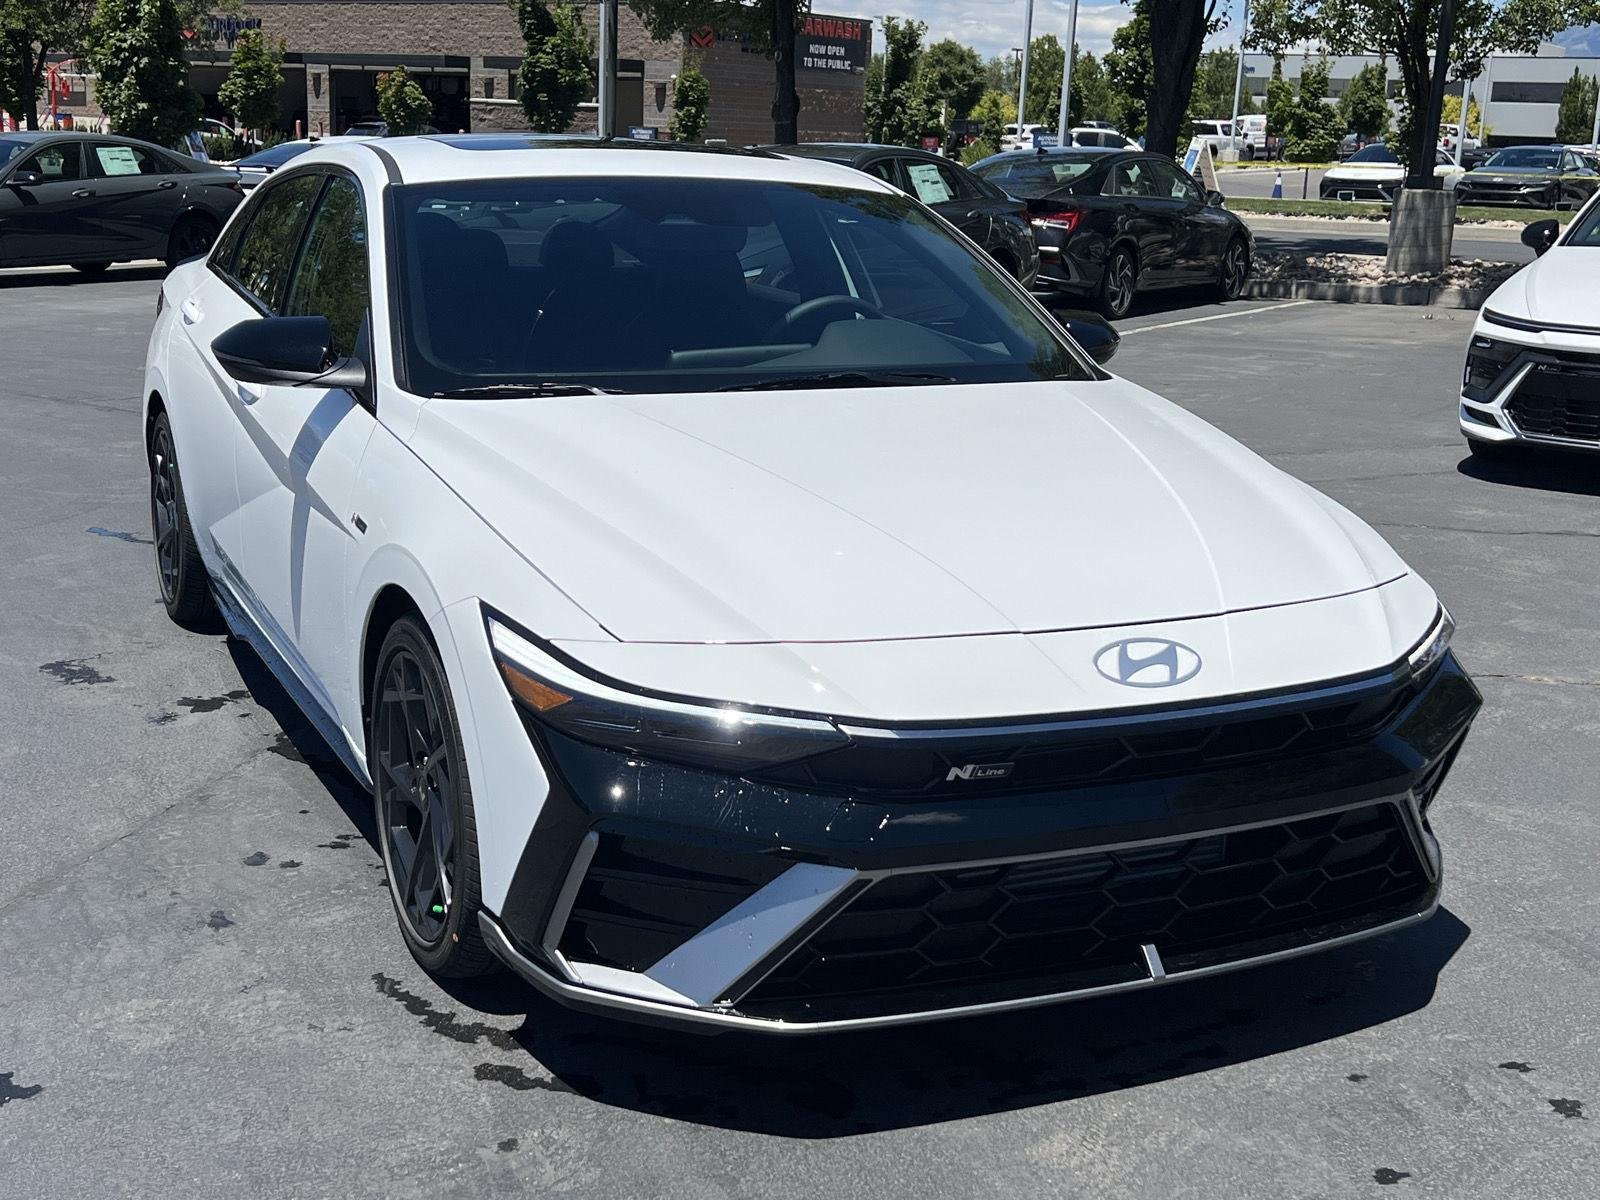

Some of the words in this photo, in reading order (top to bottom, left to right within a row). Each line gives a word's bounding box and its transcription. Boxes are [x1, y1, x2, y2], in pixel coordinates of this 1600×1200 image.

[800, 17, 861, 40] ARWASH
[809, 44, 826, 54] NOW
[827, 45, 845, 56] OPEN
[803, 57, 813, 67] TO
[813, 58, 827, 68] THE
[827, 59, 851, 70] PUBLIC
[977, 767, 1005, 777] Line
